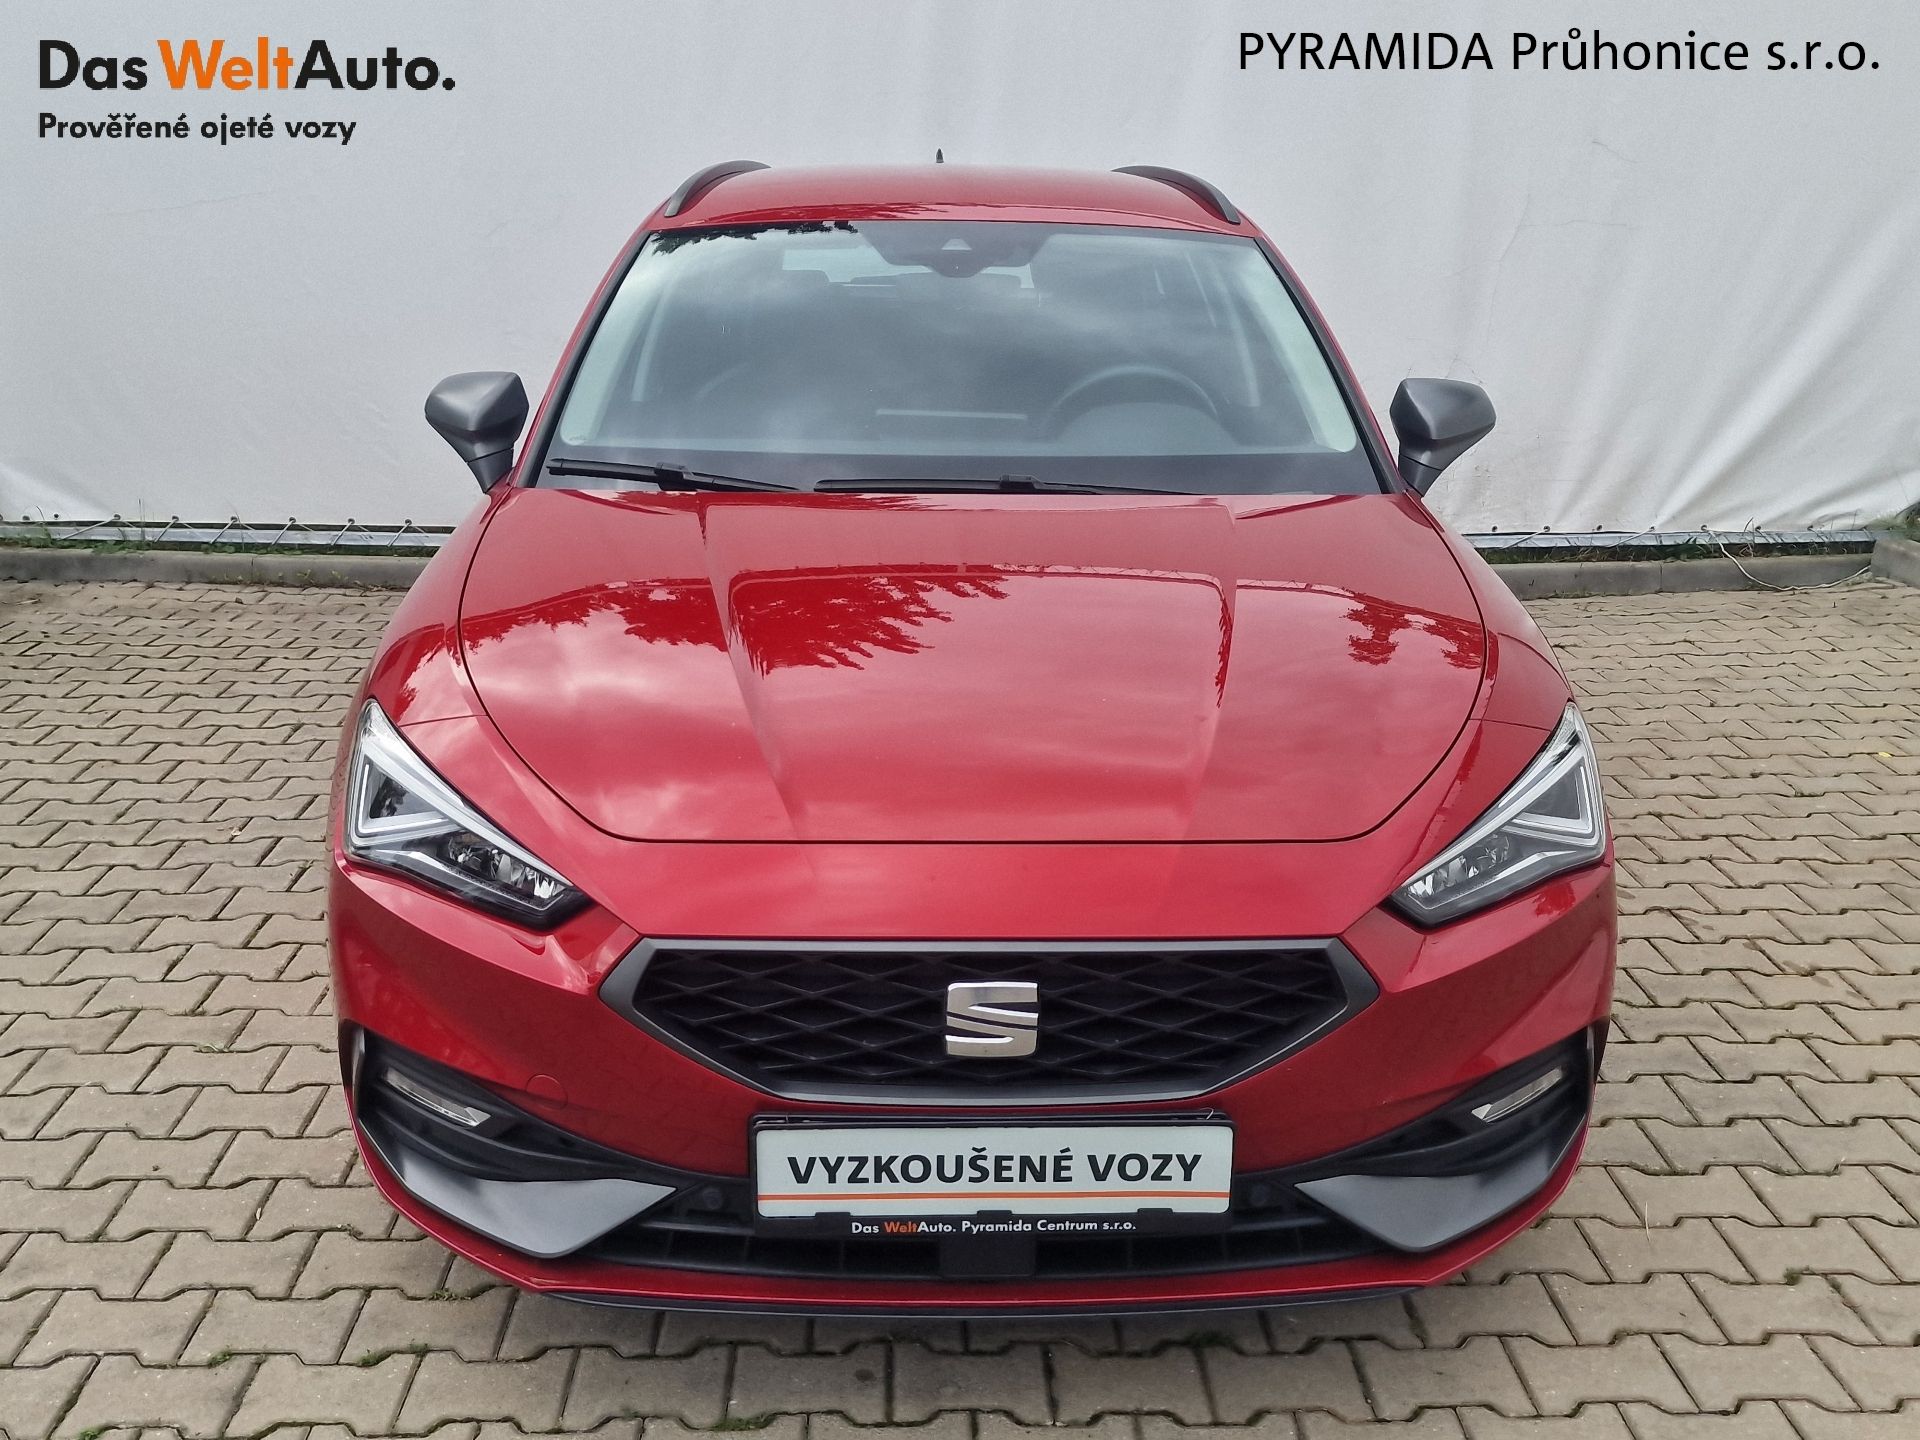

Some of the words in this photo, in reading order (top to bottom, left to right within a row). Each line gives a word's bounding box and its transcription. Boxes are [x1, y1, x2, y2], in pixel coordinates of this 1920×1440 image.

[786, 1147, 1074, 1185] VYZKOUŠENÉ
[1086, 1153, 1203, 1182] VOZY
[851, 1221, 880, 1234] Das
[961, 1219, 1033, 1236] Pyramida
[1036, 1218, 1098, 1232] Centrum
[1102, 1220, 1137, 1231] s.r.o.
